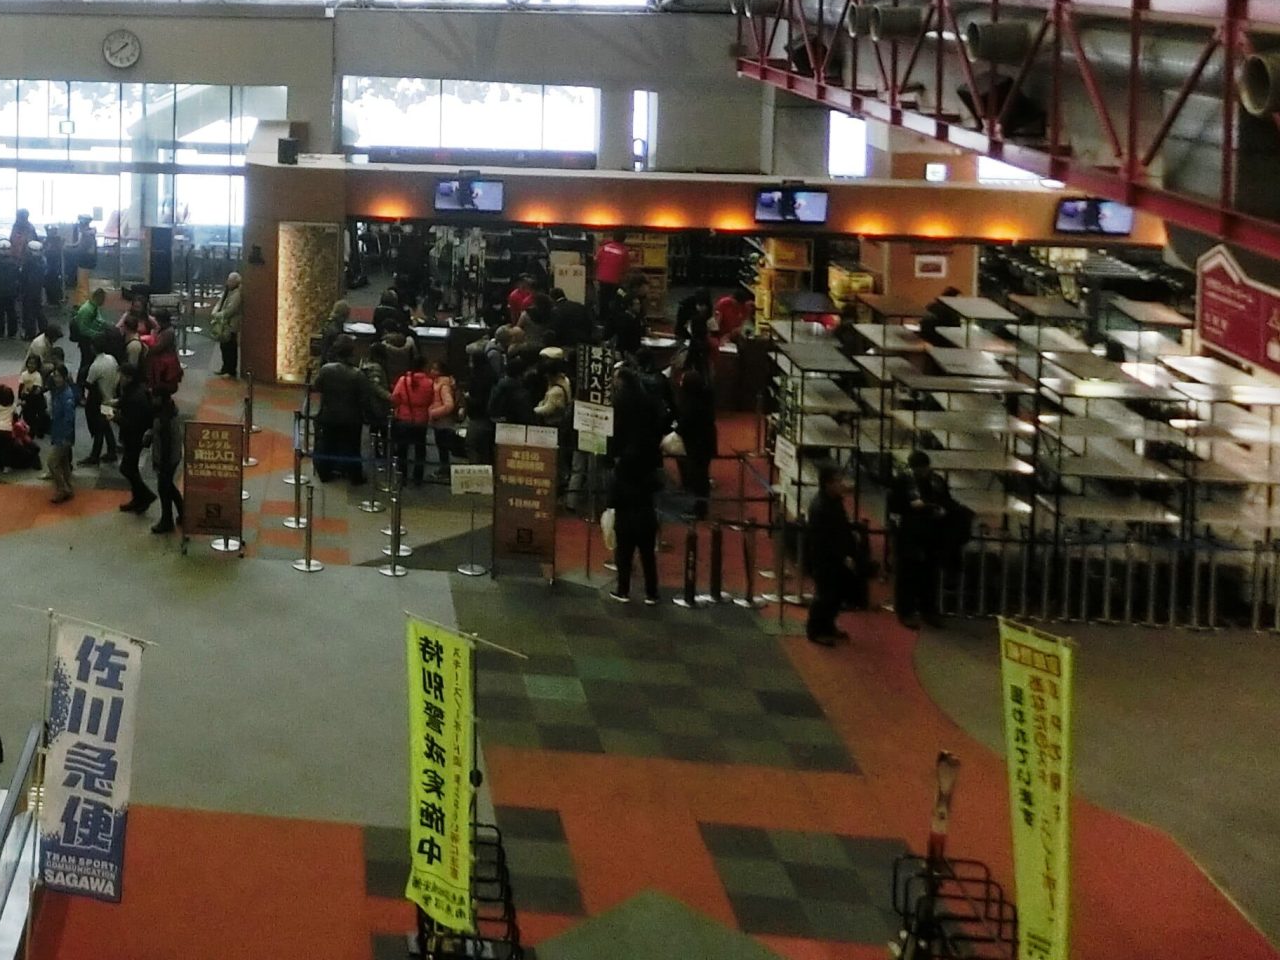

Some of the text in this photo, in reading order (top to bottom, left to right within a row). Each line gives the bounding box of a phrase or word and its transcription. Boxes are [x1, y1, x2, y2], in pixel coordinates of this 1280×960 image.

[61, 634, 130, 853] 佐川急便
[44, 868, 116, 897] SAGAWA
